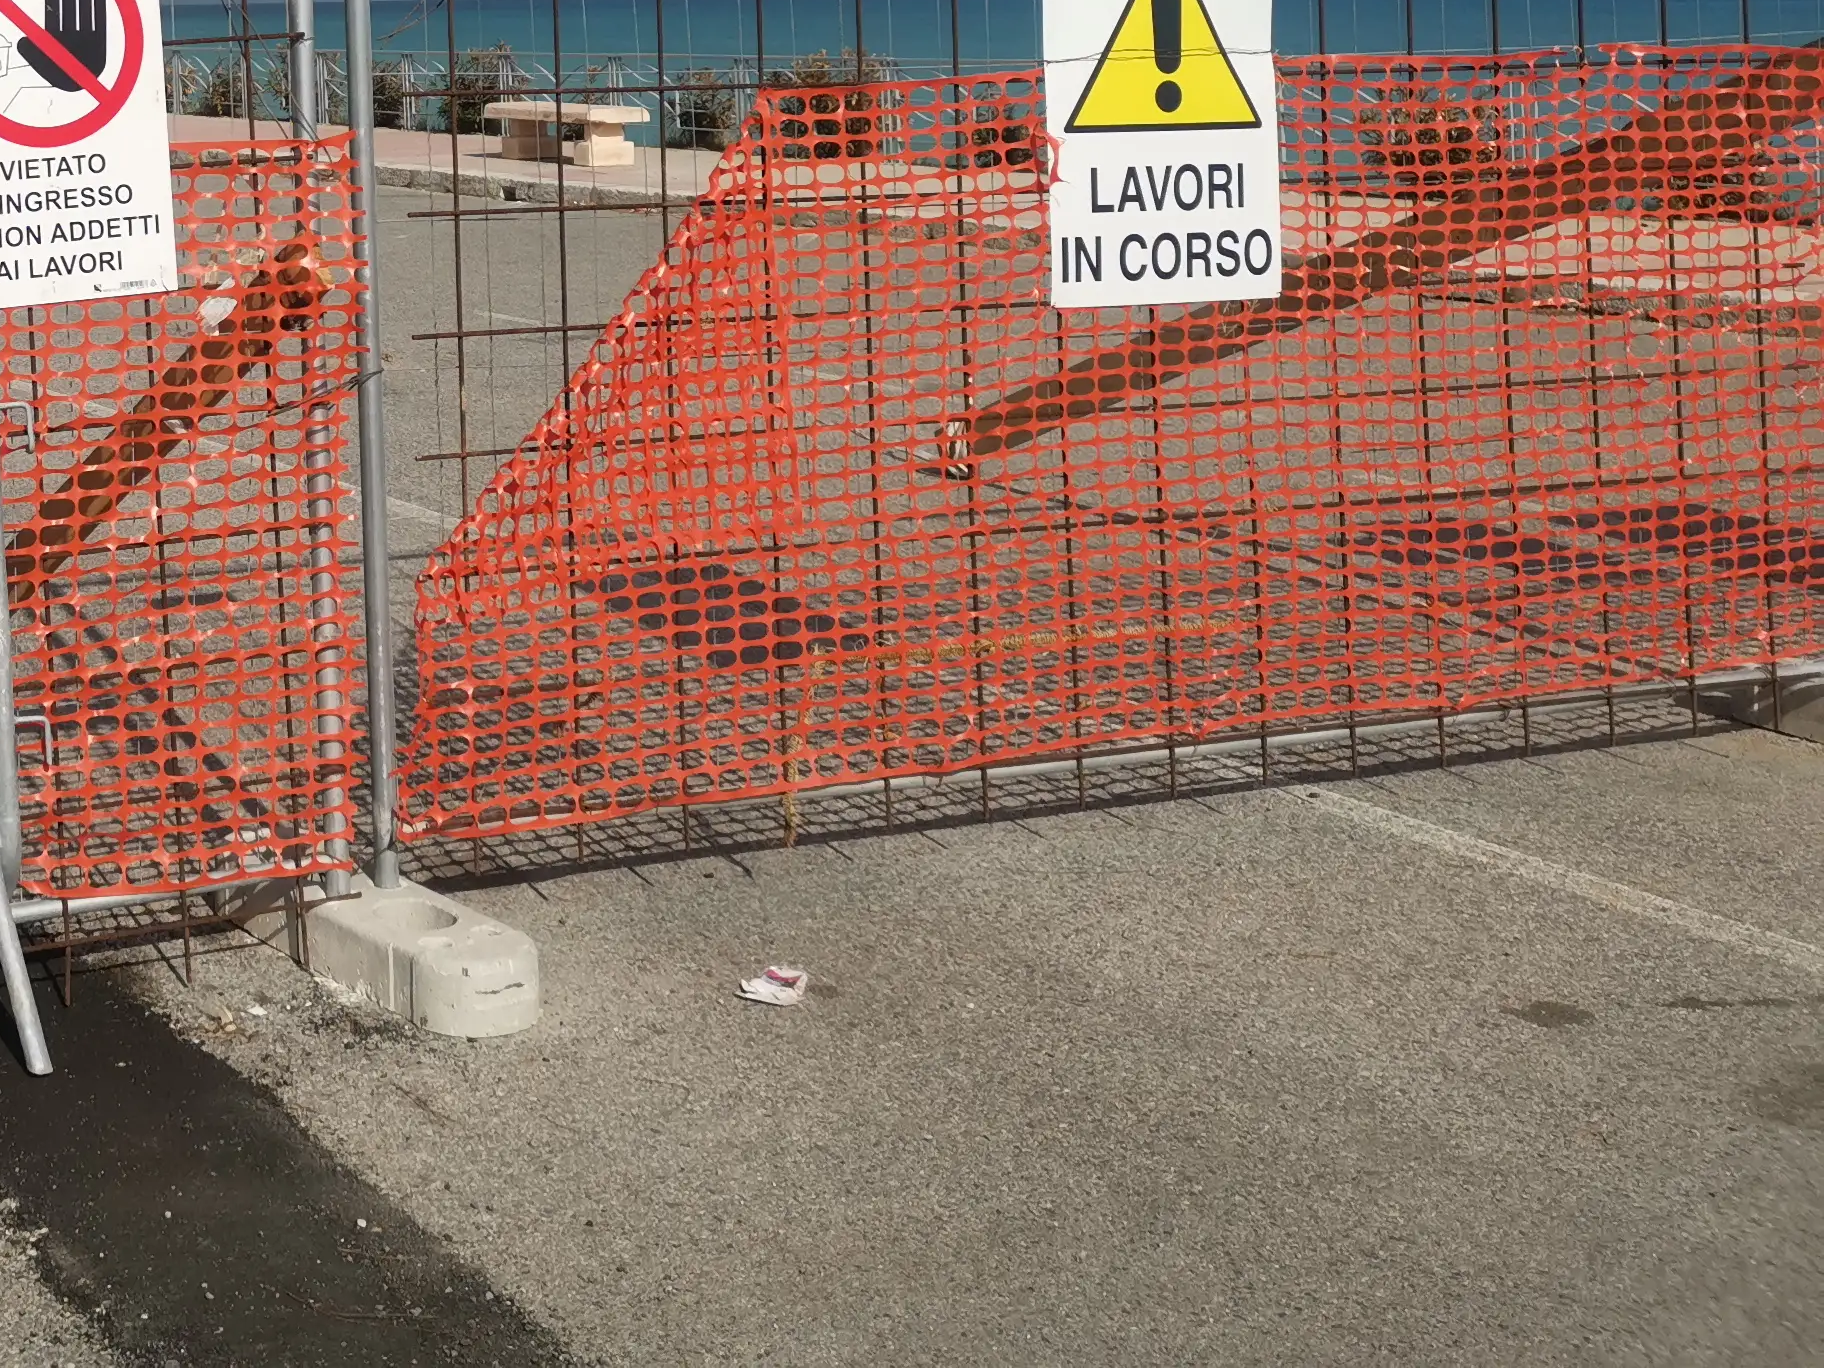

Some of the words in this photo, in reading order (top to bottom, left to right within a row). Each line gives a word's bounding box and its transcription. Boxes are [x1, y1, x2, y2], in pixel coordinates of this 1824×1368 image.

[0, 153, 106, 181] VIETATO
[1090, 162, 1245, 214] LAVORI
[50, 214, 161, 243] ADDETTI
[29, 250, 123, 279] LAVORI
[1061, 236, 1102, 283] IN
[1119, 228, 1273, 282] CORSO
